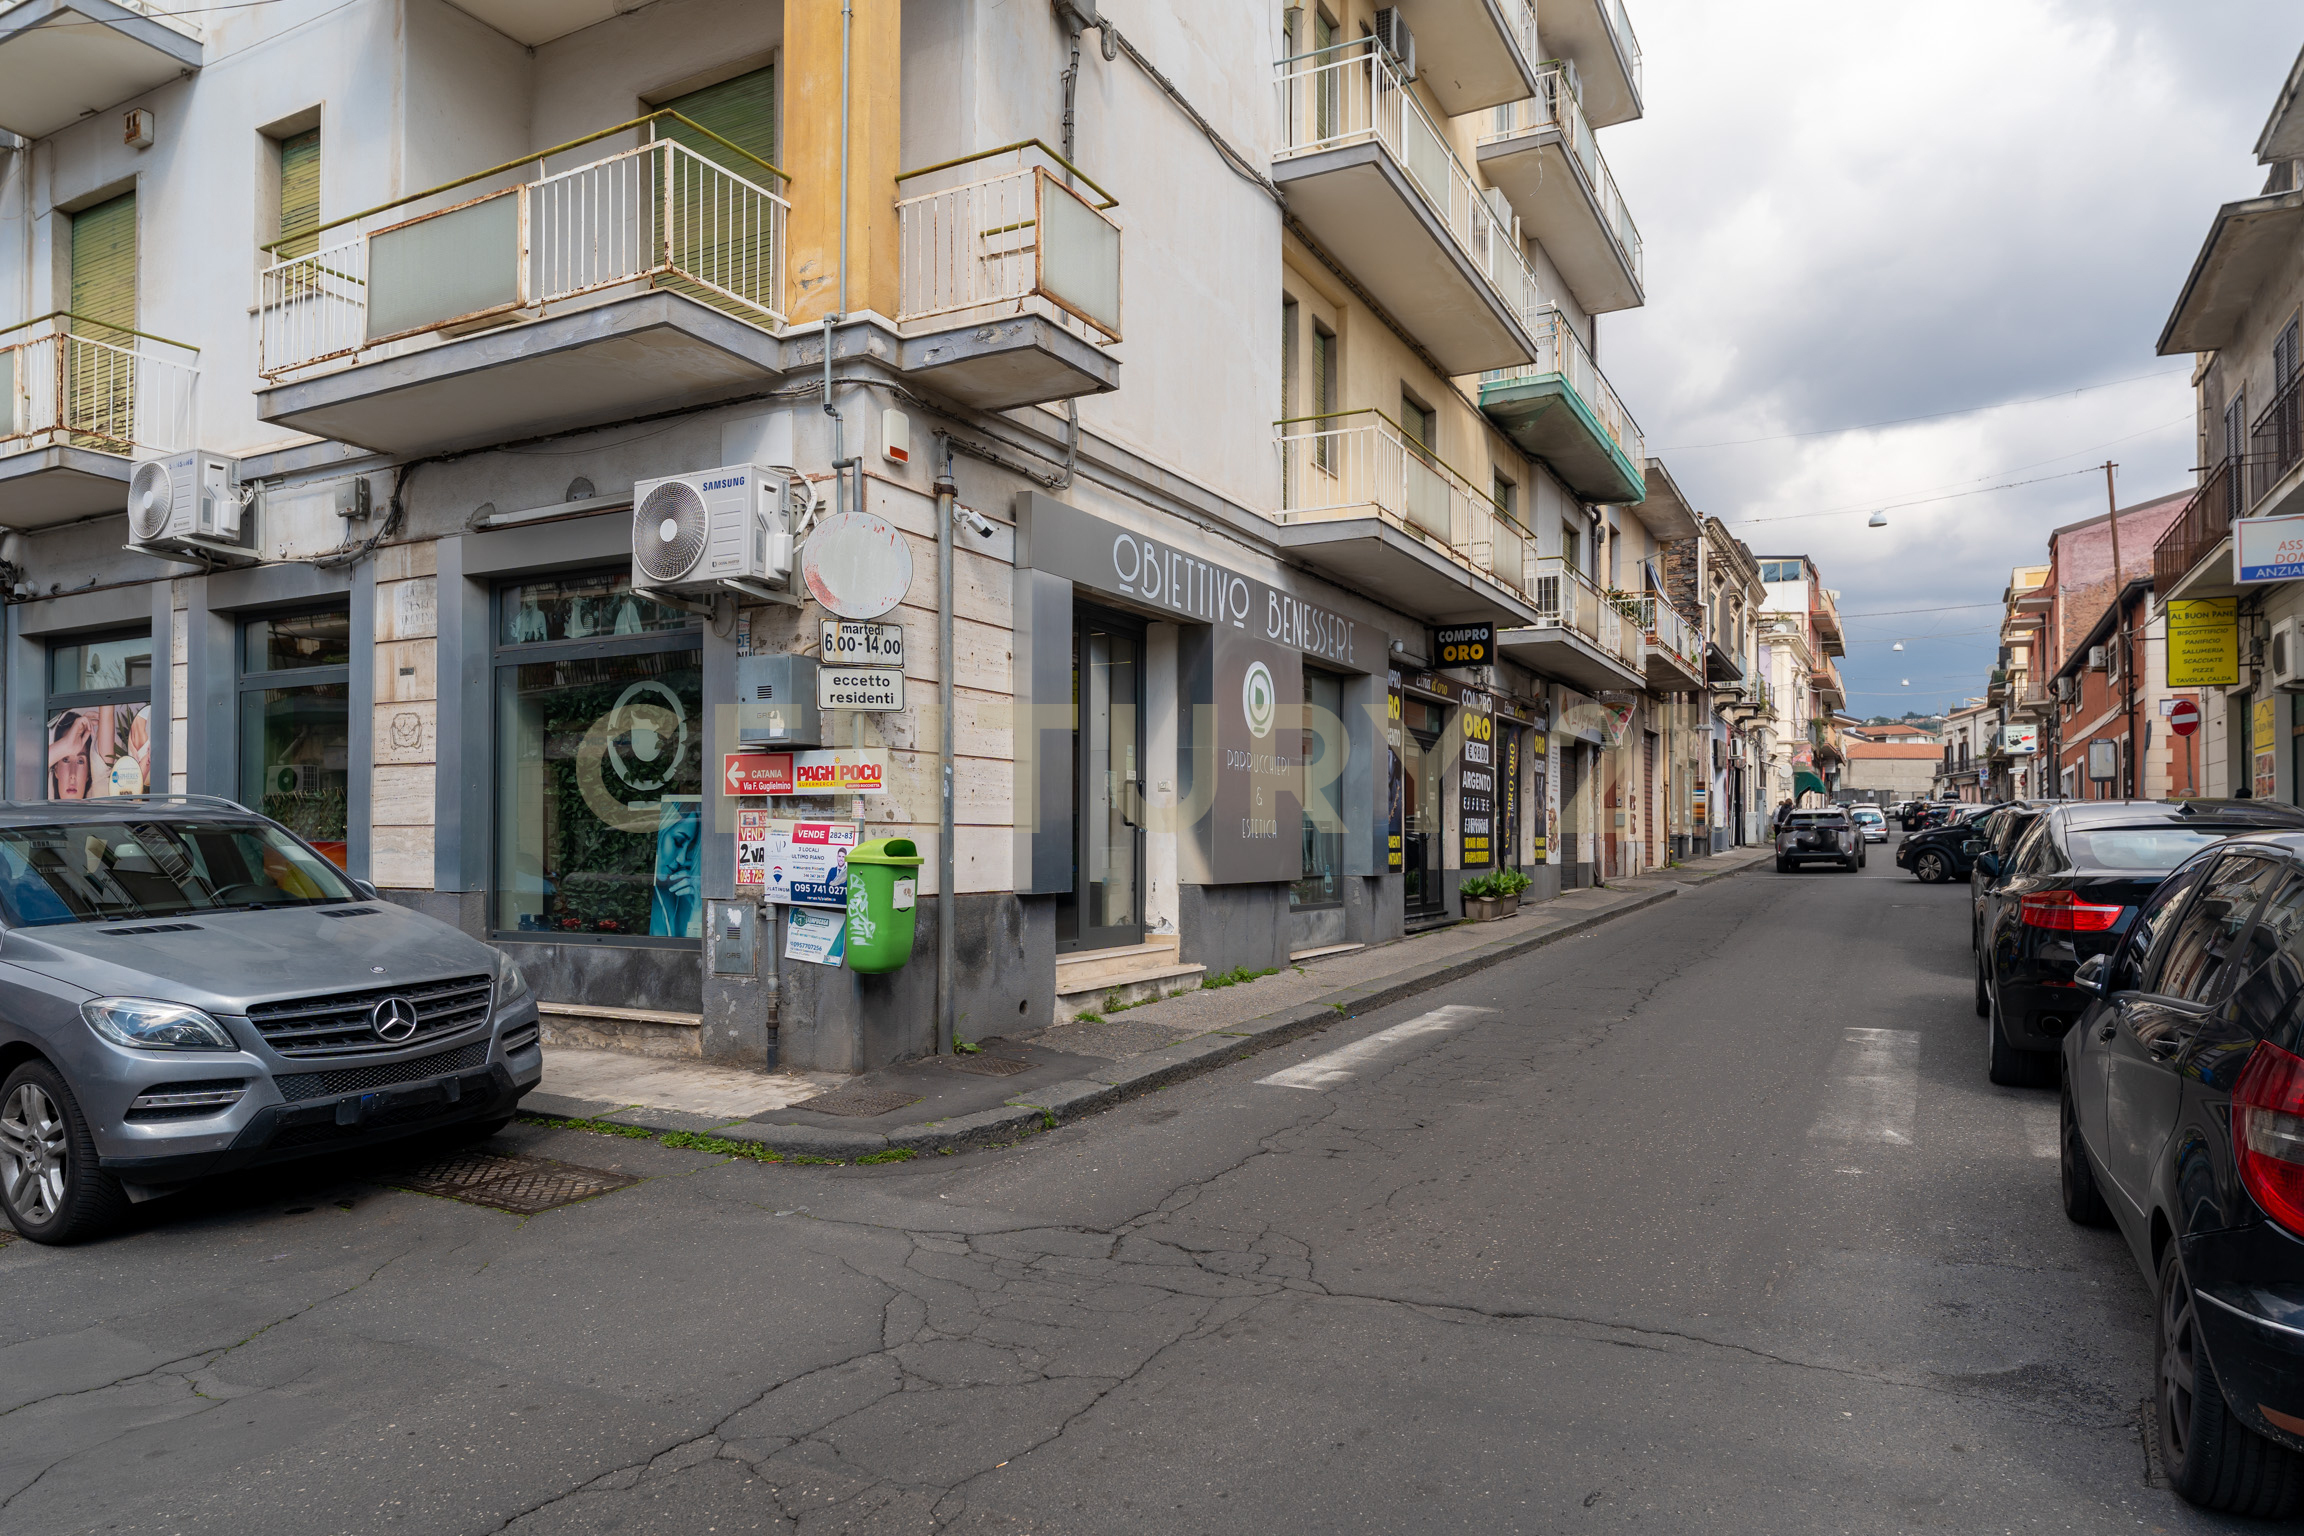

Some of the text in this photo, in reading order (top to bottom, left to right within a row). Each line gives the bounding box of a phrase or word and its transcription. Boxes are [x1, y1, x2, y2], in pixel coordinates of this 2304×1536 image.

[703, 476, 745, 492] SAMSUNG
[1113, 533, 1355, 665] OBIETTIVO BENESSERE
[2185, 611, 2209, 620] BUON
[2212, 610, 2234, 618] PANE
[1438, 628, 1489, 643] COMPRO
[2177, 628, 2229, 636] BISCOTTIFICIO
[1443, 643, 1484, 662] ORO
[2182, 647, 2224, 655] SALUMERIA
[833, 675, 891, 688] eccetto
[830, 691, 894, 705] residenti
[1461, 688, 1493, 714] COMPRO
[1463, 713, 1491, 741] ORO
[1227, 749, 1290, 777] PARRUCCHIERI
[1508, 743, 1516, 777] ORO
[751, 769, 782, 779] CATANIA
[840, 763, 882, 781] POCO
[743, 781, 791, 793] Via F. Guglielmino
[1462, 770, 1492, 793] ARGENTO
[1256, 786, 1263, 806] &
[798, 829, 825, 839] VENDE
[829, 831, 853, 840] 282-83
[1242, 818, 1277, 839] ESTETICA
[740, 843, 751, 864] 2
[740, 869, 751, 883] 095
[794, 883, 811, 893] 095
[812, 884, 827, 894] 741
